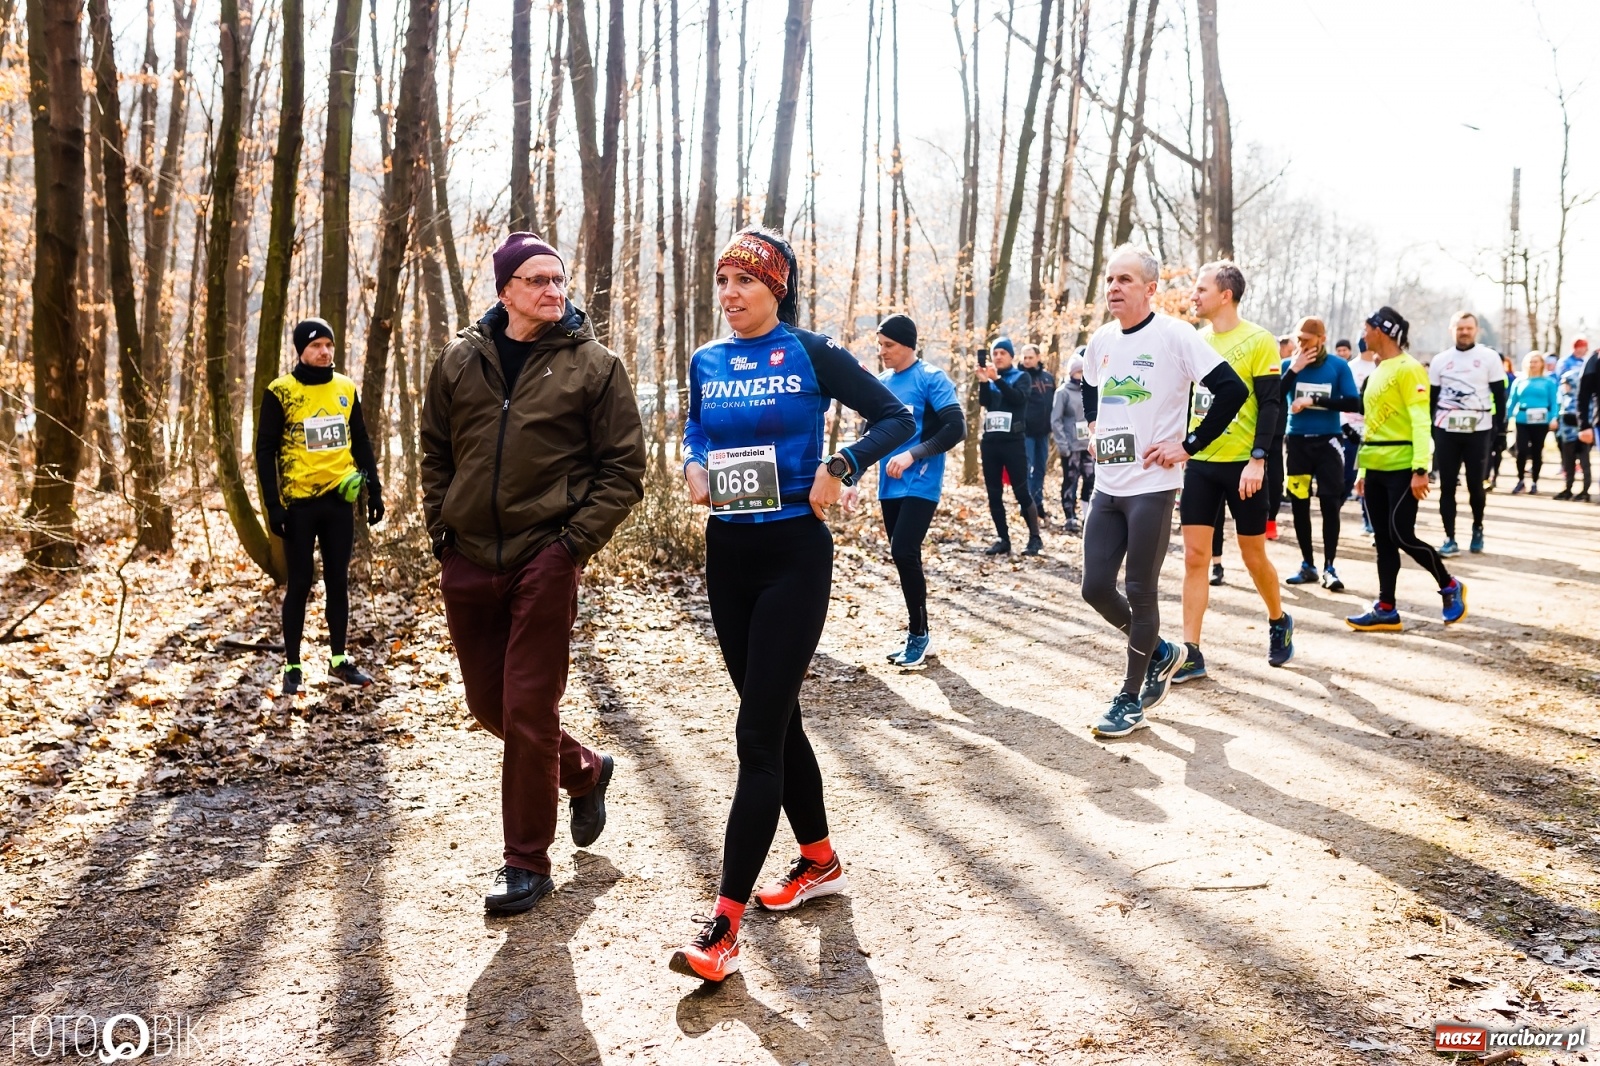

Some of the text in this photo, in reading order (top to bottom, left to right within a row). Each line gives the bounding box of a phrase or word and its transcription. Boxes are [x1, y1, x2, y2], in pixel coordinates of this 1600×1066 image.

[740, 240, 770, 261] SKIE
[748, 398, 776, 406] TEAM
[316, 426, 340, 441] 145
[726, 449, 765, 458] Twardziela
[1100, 437, 1126, 455] 084
[716, 468, 760, 495] 068
